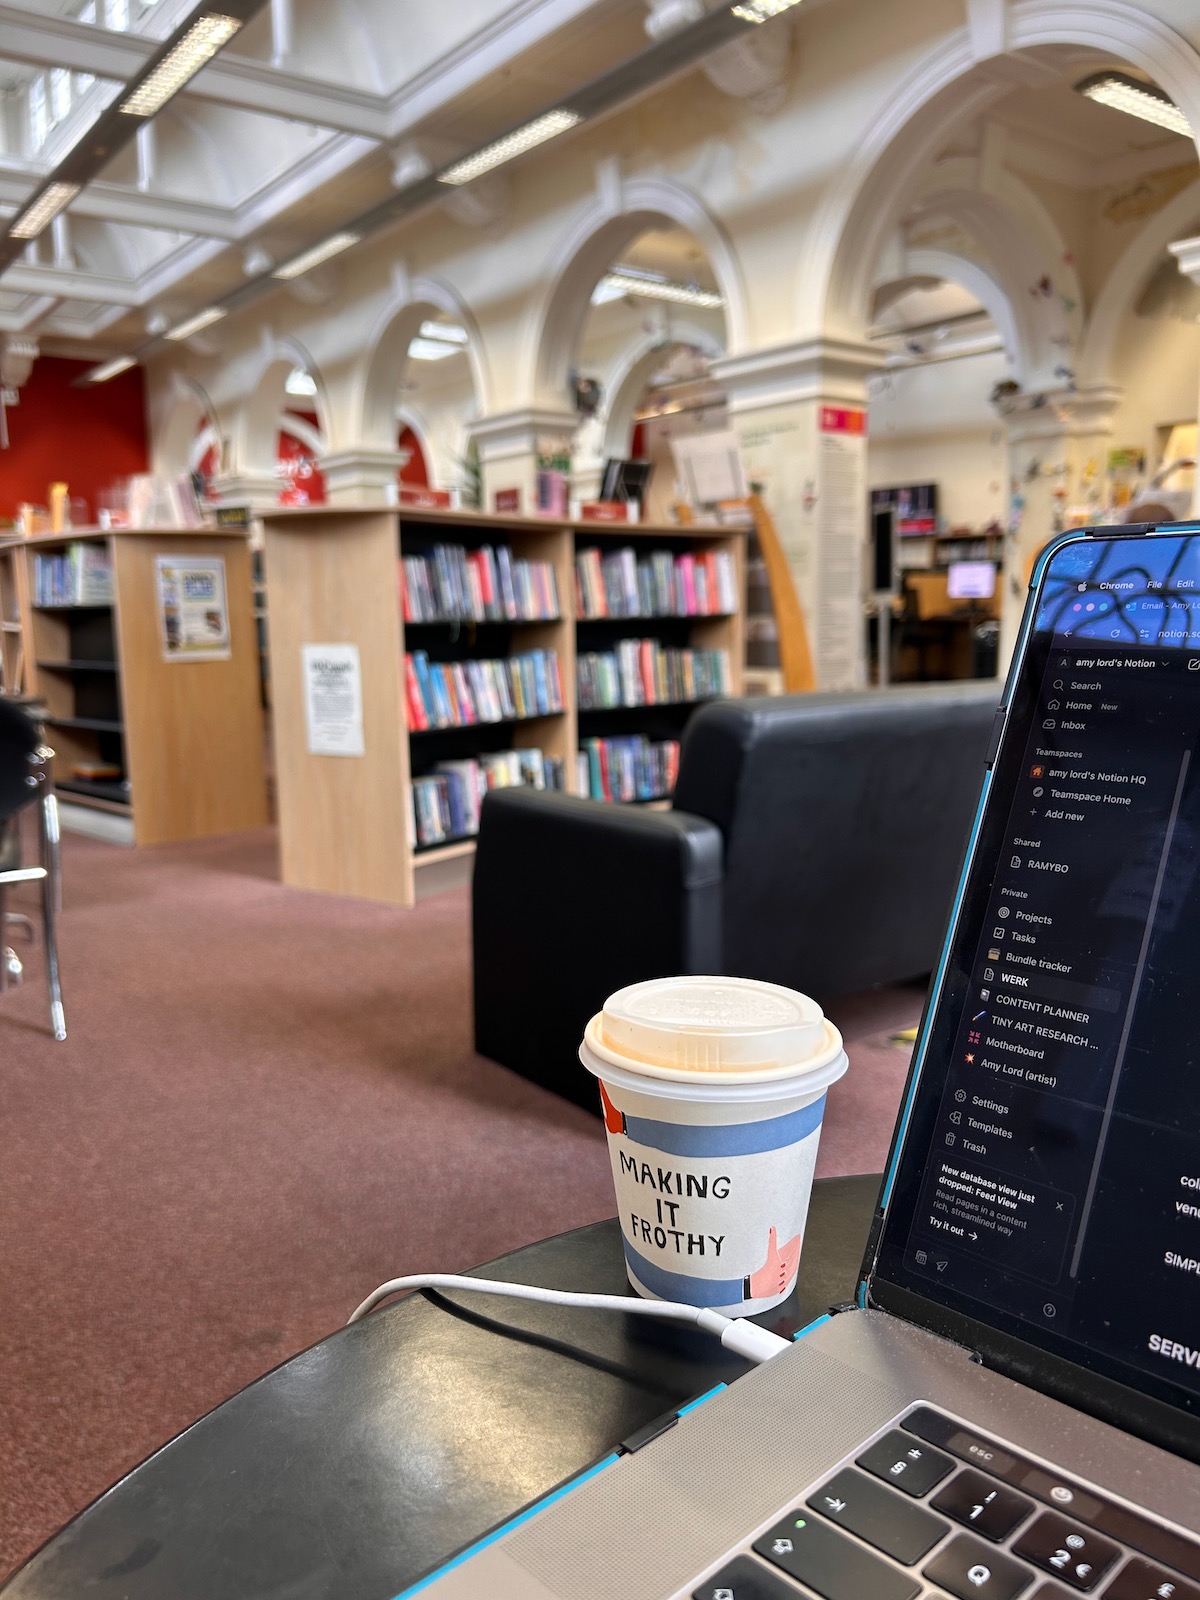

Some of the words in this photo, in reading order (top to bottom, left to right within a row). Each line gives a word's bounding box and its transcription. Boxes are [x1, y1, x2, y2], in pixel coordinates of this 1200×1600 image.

[1099, 581, 1134, 590] Chrome
[1147, 581, 1162, 589] File
[1177, 580, 1194, 588] Edit
[1141, 602, 1163, 610] Email
[1171, 602, 1190, 611] Amy
[1076, 660, 1095, 668] amy
[1097, 658, 1122, 667] lord's
[1124, 659, 1156, 668] Notion
[1070, 681, 1102, 691] Search
[1065, 701, 1092, 710] Home
[1100, 703, 1118, 711] New
[1061, 721, 1086, 730] Inbox
[1036, 748, 1083, 759] Teamspaces
[1048, 769, 1068, 780] amy
[1069, 769, 1096, 781] lord's
[1097, 773, 1129, 784] Notion
[1131, 775, 1147, 785] HQ
[1051, 789, 1102, 803] Teamspace
[1103, 794, 1132, 805] Home
[1045, 809, 1063, 820] Add
[1065, 813, 1085, 822] new
[1013, 838, 1041, 848] Shared
[1027, 860, 1069, 874] RAMYBO
[1001, 887, 1029, 899] Private
[1016, 911, 1053, 925] Projects
[1011, 931, 1036, 944] Tasks
[1006, 952, 1037, 967] Bundle
[1039, 958, 1073, 973] tracker
[1001, 972, 1029, 987] WERK
[996, 994, 1042, 1013] CONTENT
[1043, 1005, 1090, 1024] PLANNER
[991, 1015, 1013, 1029] TINY
[1014, 1020, 1035, 1034] ART
[1035, 1026, 1089, 1047] RESEARCH
[986, 1037, 1045, 1060] Motherboard
[980, 1058, 1001, 1072] Amy
[1002, 1063, 1023, 1078] Lord
[1025, 1069, 1057, 1087] (artist)
[972, 1095, 1010, 1115] Settings
[967, 1117, 1013, 1139] Templates
[962, 1138, 987, 1155] Trash
[619, 1150, 732, 1199] MAKING
[941, 1164, 959, 1177] New
[959, 1170, 997, 1190] database
[998, 1183, 1018, 1197] view
[1017, 1190, 1036, 1204] just
[938, 1175, 975, 1195] dropped:
[975, 1188, 996, 1203] Feed
[997, 1195, 1018, 1210] View
[656, 1199, 680, 1227] IT
[935, 1189, 955, 1202] Read
[955, 1197, 979, 1212] pages
[980, 1205, 988, 1215] in
[996, 1212, 1028, 1229] content
[929, 1215, 942, 1229] Try
[943, 1220, 950, 1231] it
[950, 1225, 965, 1237] out
[933, 1200, 949, 1214] rich,
[951, 1207, 996, 1229] streamlined
[997, 1225, 1014, 1237] way
[631, 1213, 726, 1257] FROTHY
[969, 1445, 994, 1460] esc
[969, 1504, 985, 1520] 1
[1048, 1549, 1072, 1569] 2
[967, 1564, 991, 1587] Q
